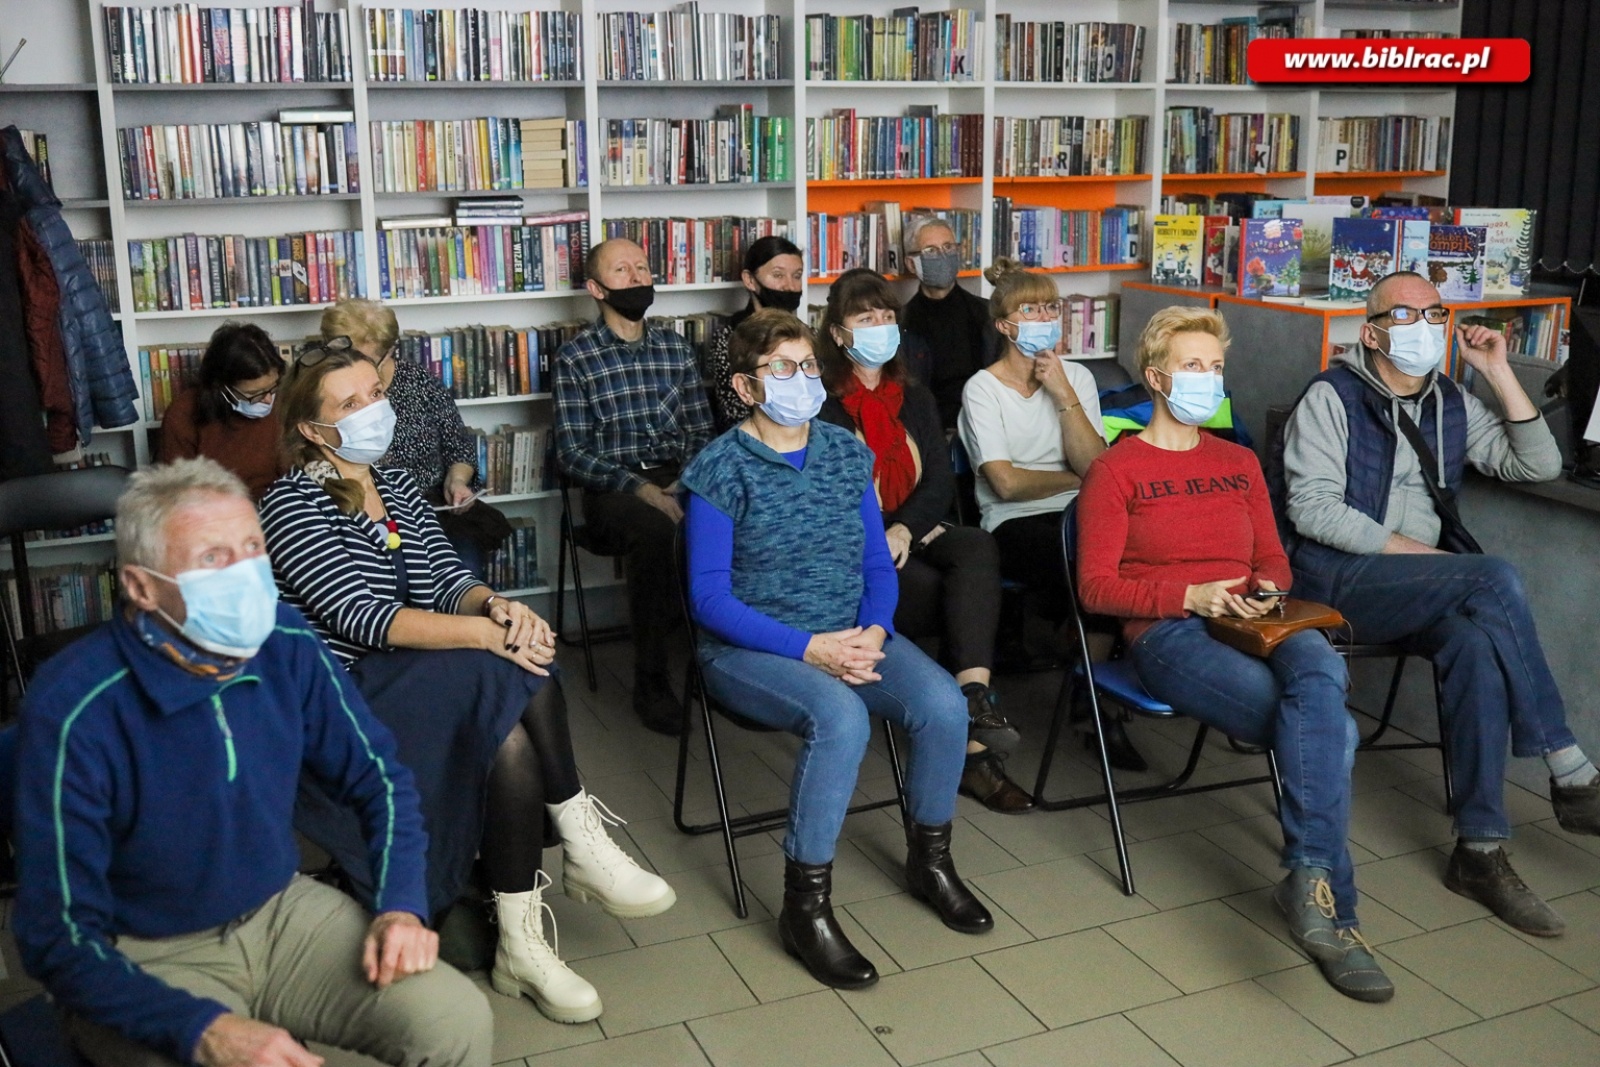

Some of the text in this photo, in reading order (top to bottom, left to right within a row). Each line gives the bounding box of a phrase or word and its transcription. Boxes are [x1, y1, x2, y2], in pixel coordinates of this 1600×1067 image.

[954, 55, 965, 74] K
[1057, 151, 1067, 168] R
[1255, 149, 1267, 167] K
[1336, 149, 1347, 166] P
[292, 238, 301, 261] KING
[513, 243, 523, 273] WIZJER
[1062, 251, 1069, 264] C
[1129, 241, 1137, 258] D
[889, 250, 898, 269] R
[1138, 473, 1250, 500] LEE JEANS
